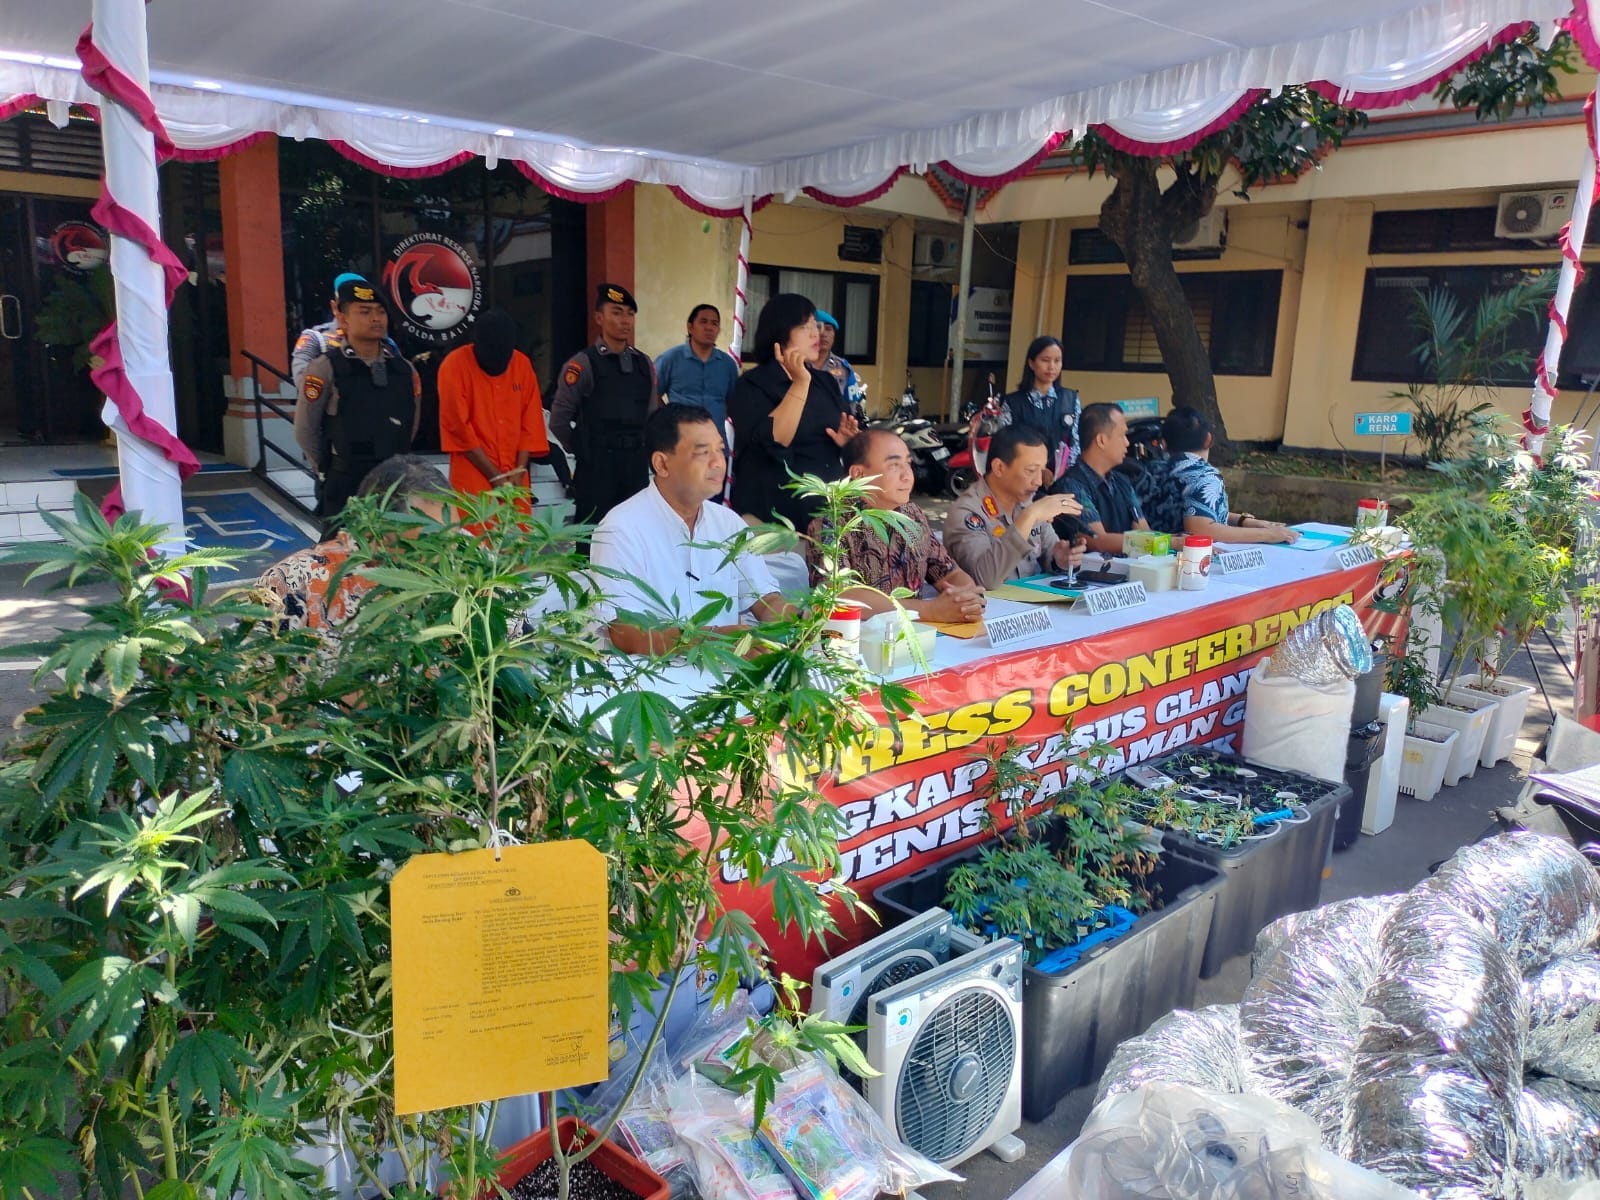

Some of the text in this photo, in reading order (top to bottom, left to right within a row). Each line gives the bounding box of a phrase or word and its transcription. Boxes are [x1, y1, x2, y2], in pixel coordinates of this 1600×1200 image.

[393, 232, 482, 311] DIREKTORAT RESERSE NARKOBA
[402, 321, 468, 341] POLDA BALI
[1368, 414, 1398, 424] KARO
[1368, 424, 1398, 432] RENA
[1340, 546, 1375, 568] GANJA
[1087, 585, 1146, 613] KABID HUMAS
[987, 611, 1053, 644] DIRRESNARKOBA
[1049, 591, 1354, 717] CONFEREN
[1155, 667, 1254, 724] CLAN
